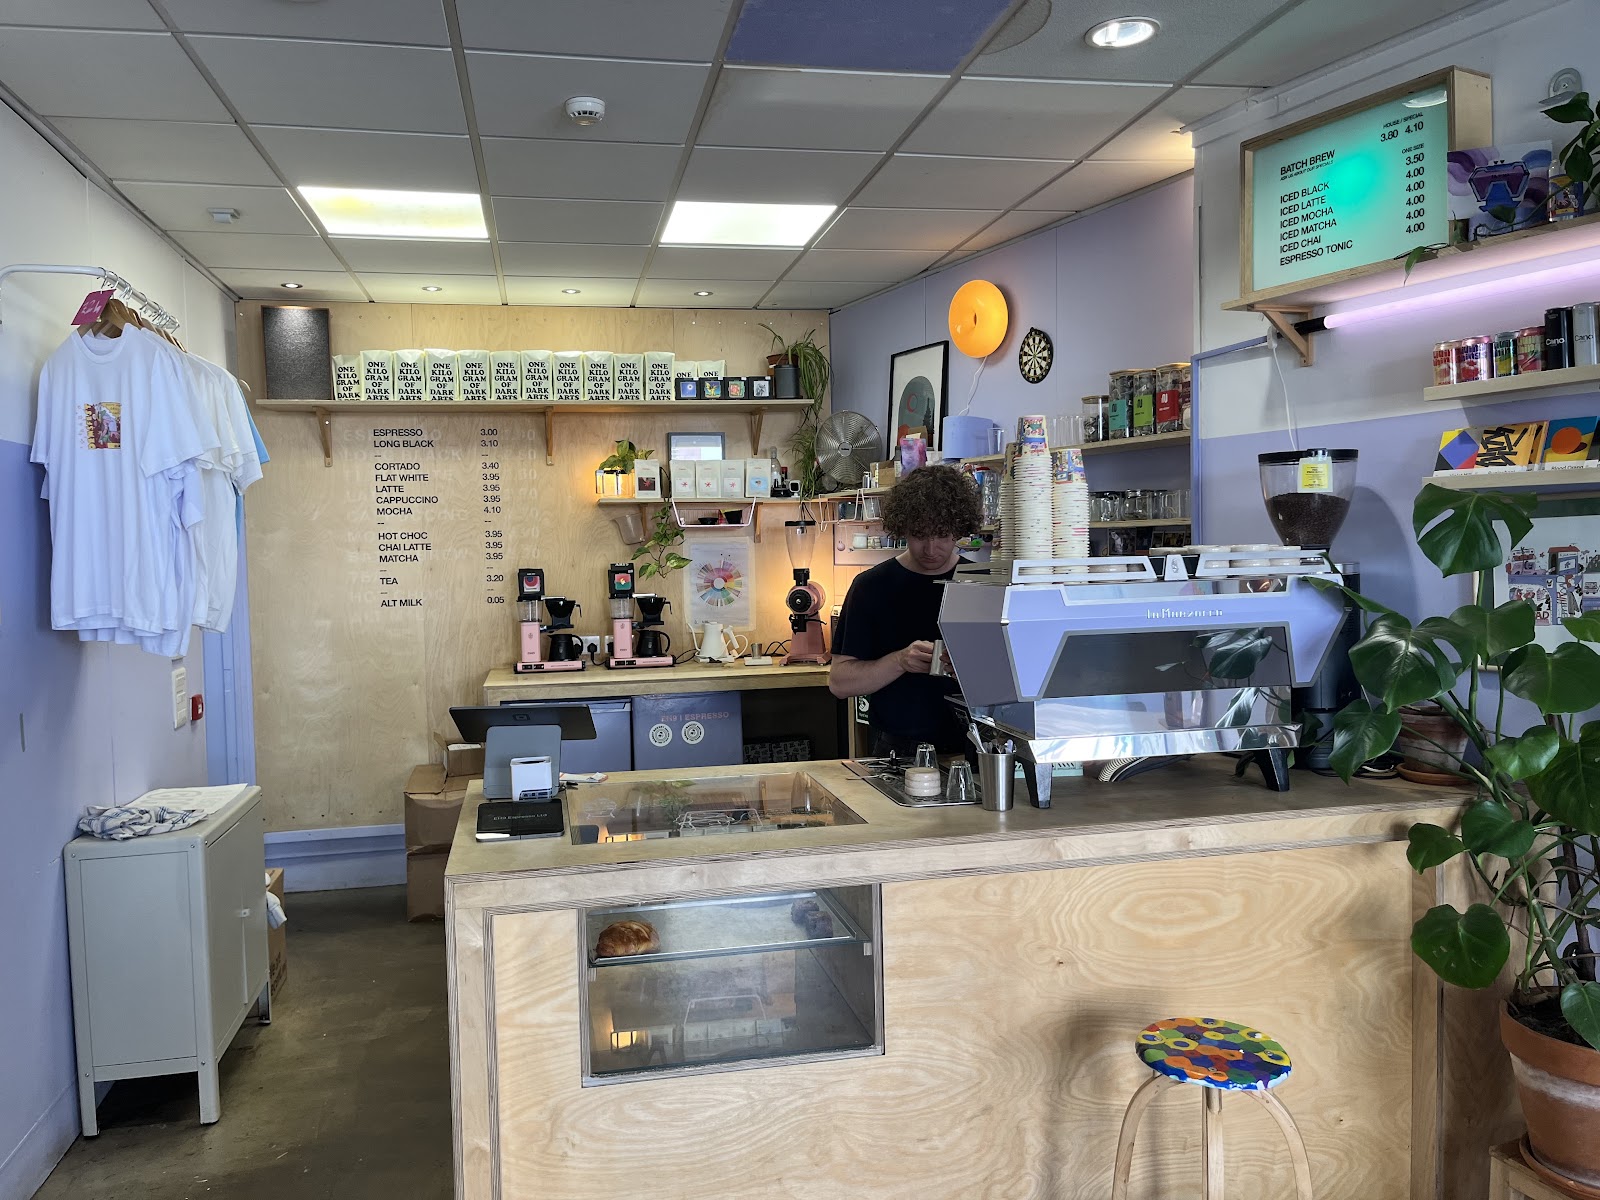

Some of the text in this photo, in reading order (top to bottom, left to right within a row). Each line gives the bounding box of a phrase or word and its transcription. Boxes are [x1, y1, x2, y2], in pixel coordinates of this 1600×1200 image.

[1383, 119, 1400, 129] HOUSE
[1403, 112, 1423, 122] SPECIAL
[1380, 121, 1424, 142] 3.80 4.10
[1413, 143, 1424, 151] SIZE
[1280, 149, 1335, 175] BATCH BREW
[1405, 153, 1425, 165] 3.50
[1405, 167, 1425, 179] 4.00
[1405, 181, 1425, 193] 4.00
[1280, 181, 1330, 204] ICED BLACK
[1405, 194, 1425, 206] 4.00
[1280, 195, 1326, 216] ICED LATTE
[1280, 206, 1334, 229] ICED MOCHA
[1405, 208, 1425, 220] 4.00
[1280, 218, 1337, 241] ICED MATCHA
[1405, 222, 1425, 234] 4.00
[1280, 235, 1321, 253] ICED CHAI
[1280, 240, 1353, 266] ESPRESSO TONIC
[373, 429, 423, 437] ESPRESSO
[480, 428, 497, 436] 3.00
[374, 440, 434, 448] LONG BLACK
[482, 473, 500, 481] 3.95
[376, 485, 404, 493] LATTE
[483, 484, 500, 492] 3.95
[376, 496, 438, 504] CAPPUCCINO
[483, 495, 501, 503] 3.95
[377, 507, 413, 515] MOCHA
[484, 506, 501, 514] 4.10
[378, 532, 398, 540] HOT
[400, 532, 428, 540] CHOC
[485, 530, 502, 538] 3.95
[403, 543, 432, 551] LATTE
[485, 541, 503, 549] 3.95
[379, 555, 419, 563] MATCHA
[486, 574, 504, 582] 3.20
[400, 599, 422, 607] MILK
[487, 596, 505, 604] 0.05
[684, 711, 729, 721] ESPRESSO
